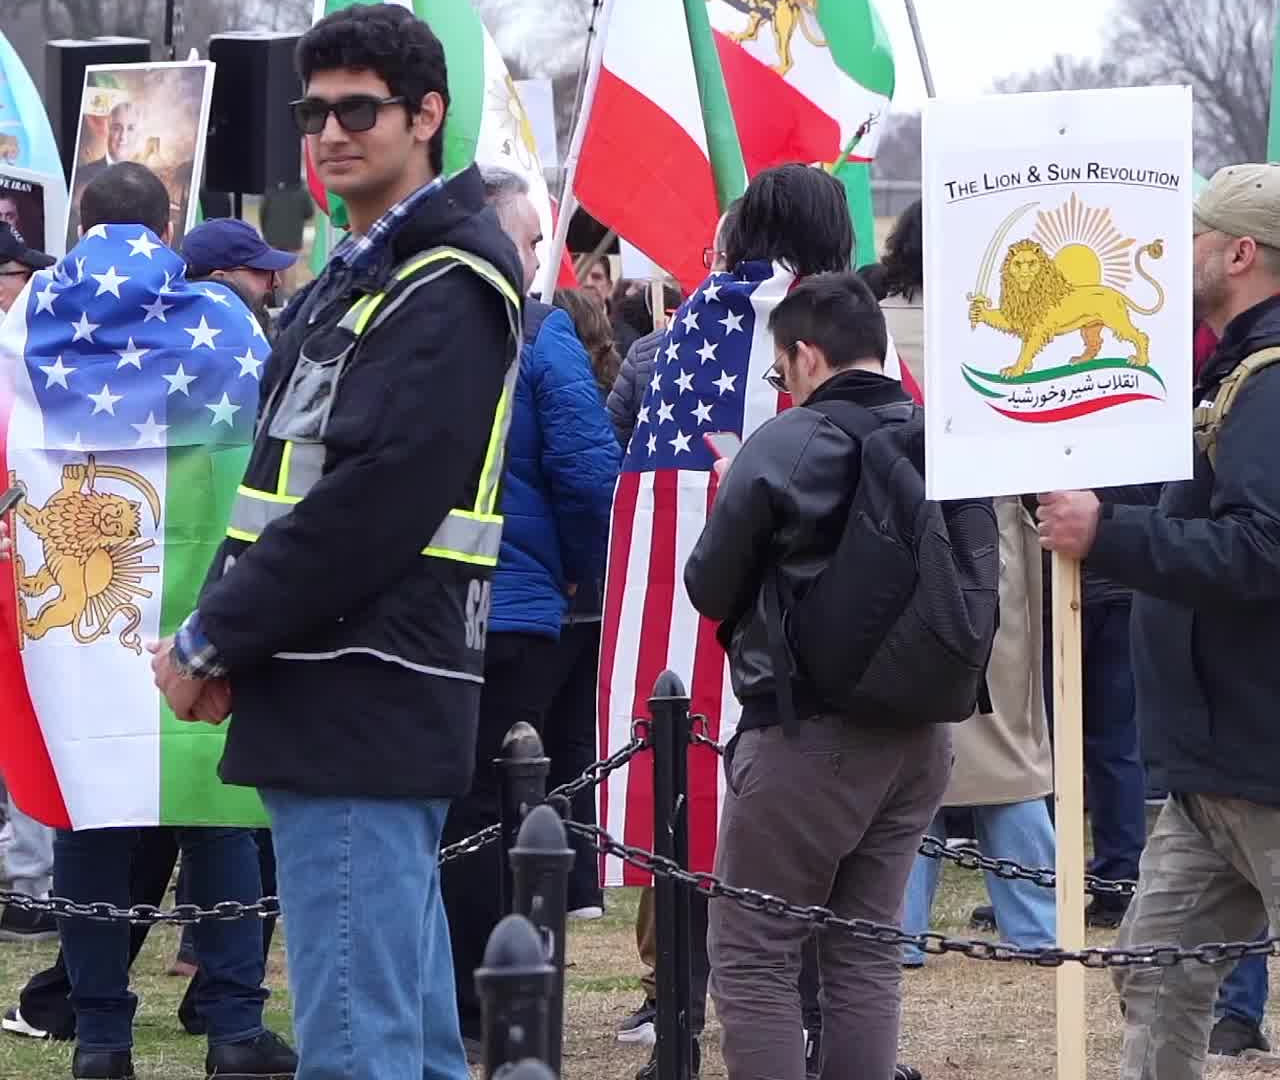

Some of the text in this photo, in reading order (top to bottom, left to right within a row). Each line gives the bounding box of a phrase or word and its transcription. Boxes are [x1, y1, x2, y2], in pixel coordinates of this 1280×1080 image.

[945, 162, 1180, 199] THE LION & SUN REVOLUTION
[1097, 374, 1140, 394] انقلاب
